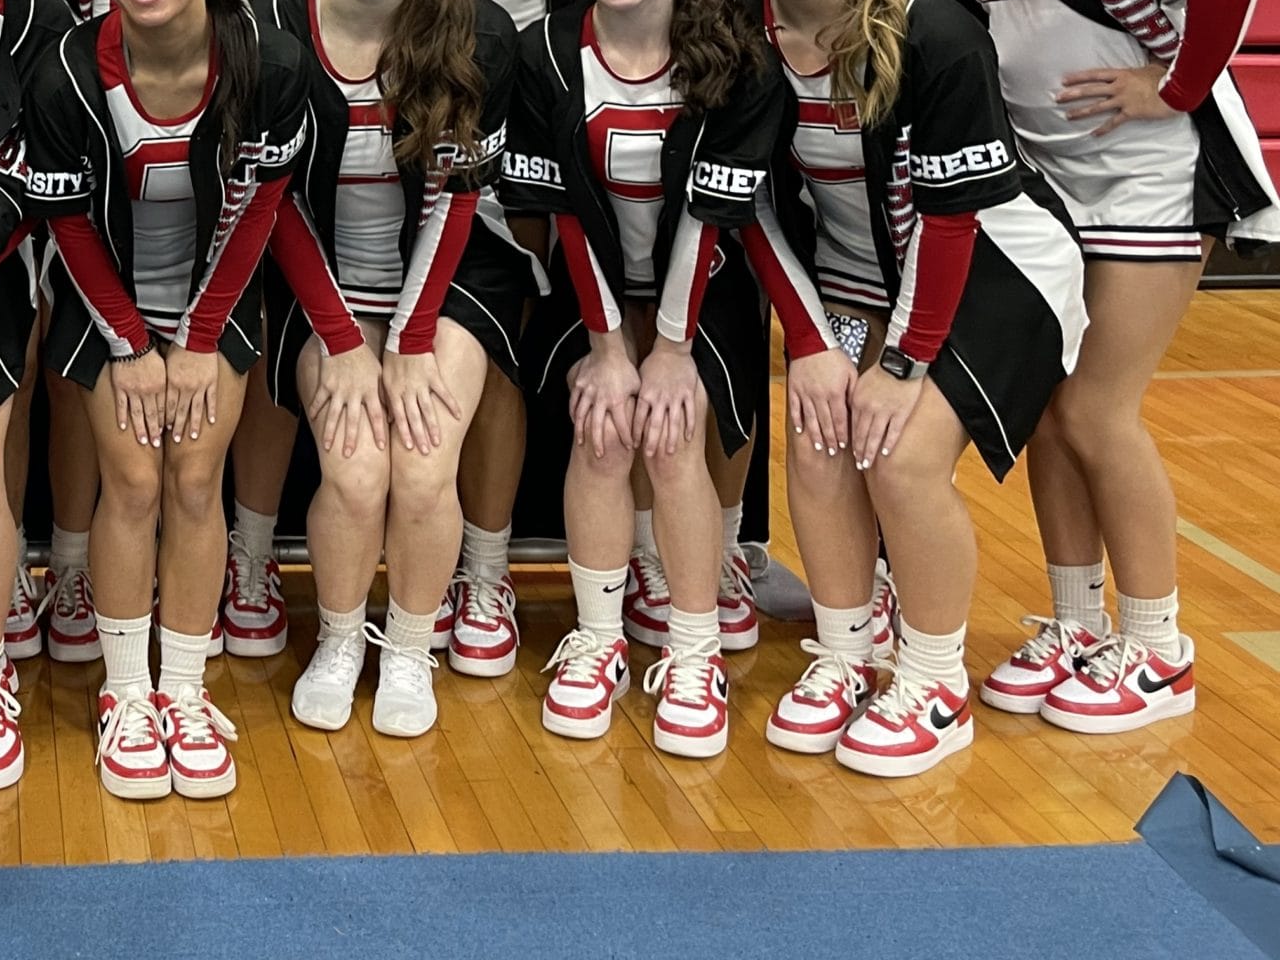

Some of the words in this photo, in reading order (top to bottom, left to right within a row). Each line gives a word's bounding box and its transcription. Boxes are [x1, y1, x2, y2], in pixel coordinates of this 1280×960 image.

[501, 150, 562, 185] ARSIT
[909, 139, 1010, 180] CHEER
[25, 165, 82, 195] SITY
[695, 160, 768, 195] CHE
